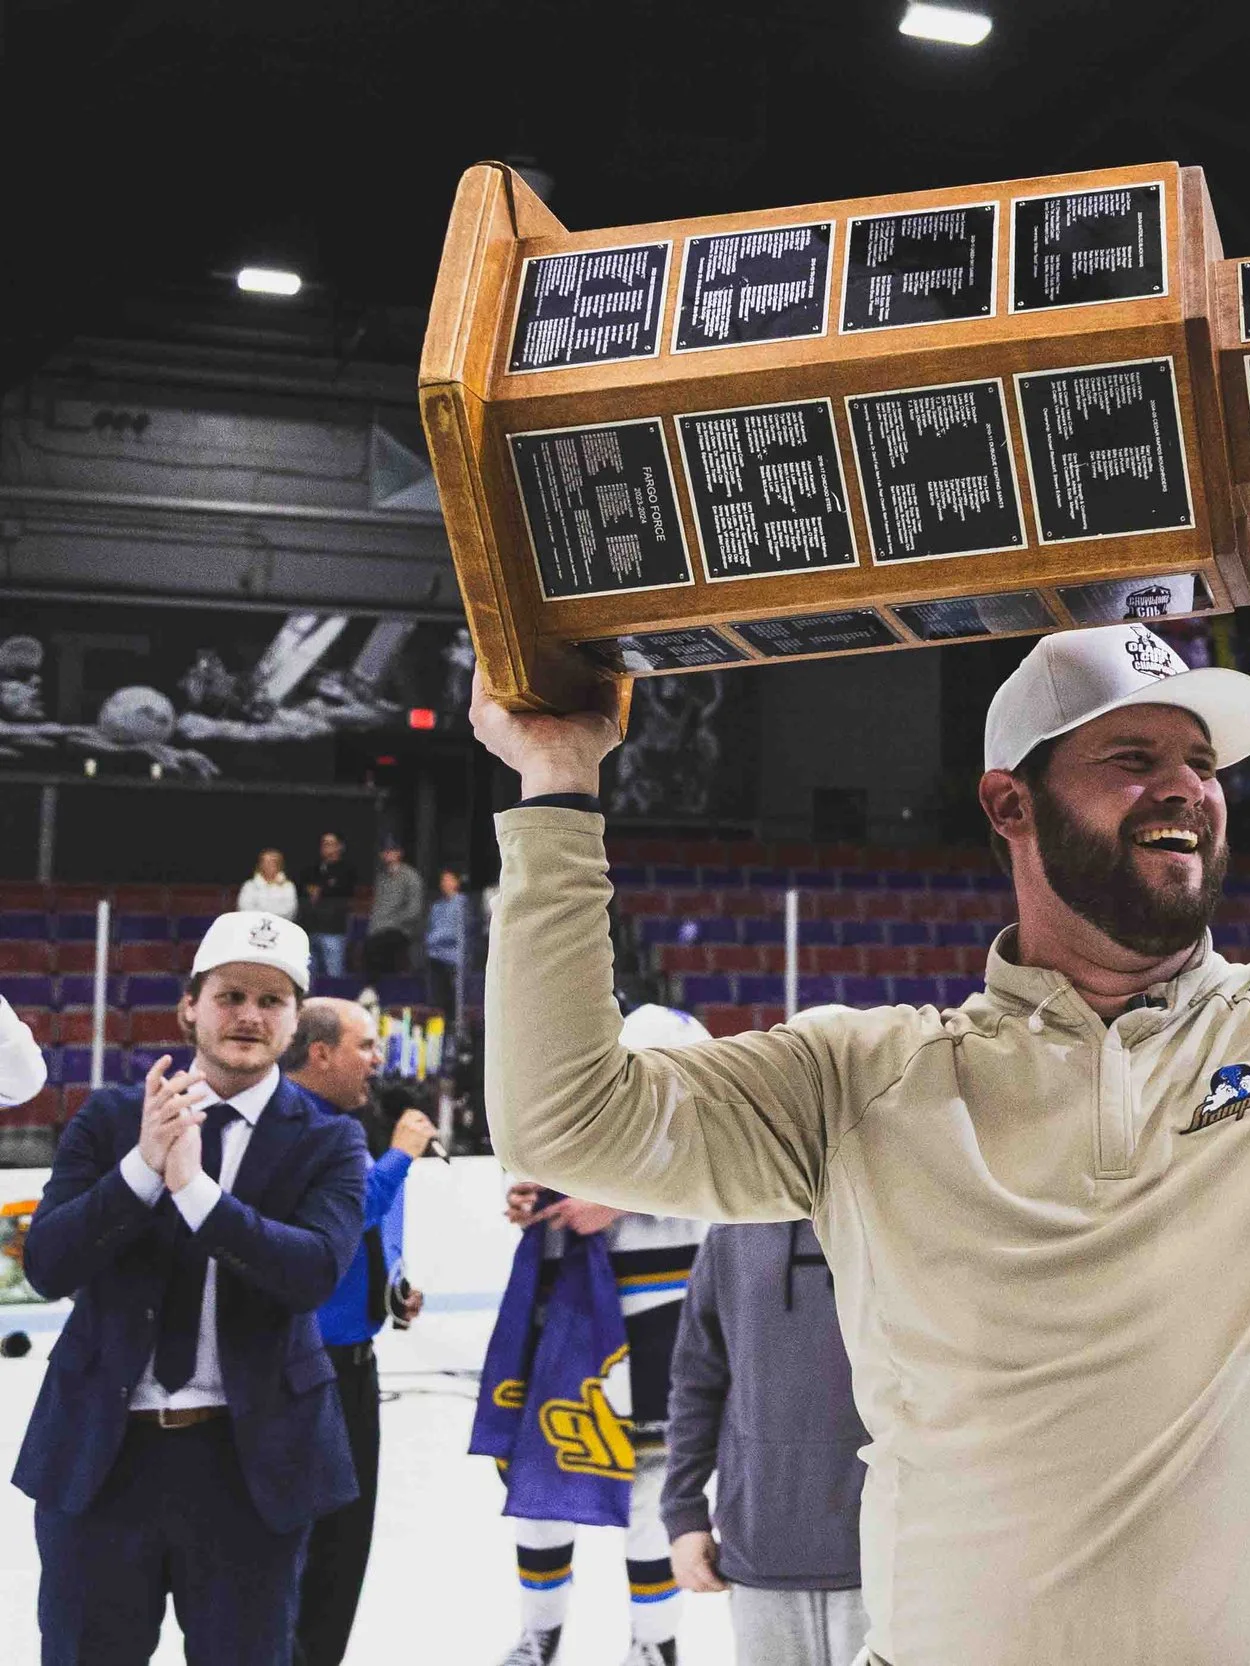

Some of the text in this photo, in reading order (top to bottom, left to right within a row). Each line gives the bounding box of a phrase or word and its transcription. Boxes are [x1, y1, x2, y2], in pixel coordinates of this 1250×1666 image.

[820, 473, 829, 497] CHICAGO
[633, 487, 647, 523] 2023-2024
[641, 465, 666, 542] FARGO FORCE
[824, 497, 832, 512] STEEL
